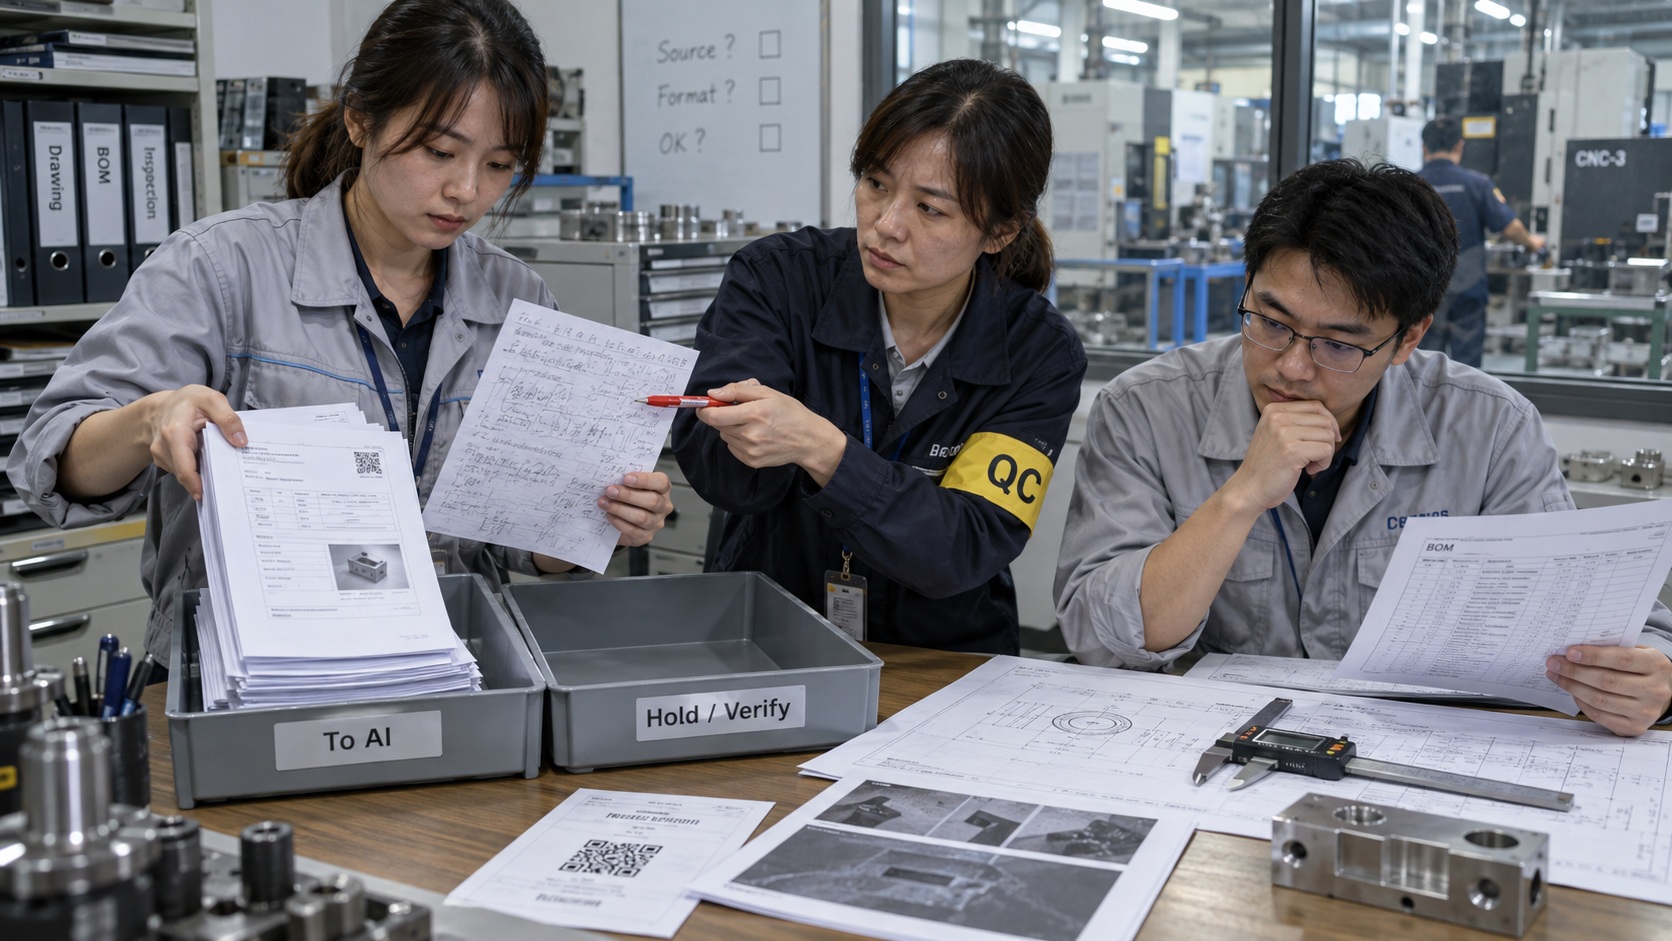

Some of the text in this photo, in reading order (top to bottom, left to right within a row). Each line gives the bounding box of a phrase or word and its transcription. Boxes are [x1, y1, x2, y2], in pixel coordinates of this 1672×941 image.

[656, 32, 736, 64] Source ?
[657, 78, 736, 108] Format ?
[659, 127, 706, 155] OK ?
[97, 146, 111, 184] BOM
[1575, 149, 1626, 167] CNC-3
[48, 145, 64, 211] Drawing
[142, 146, 158, 219] Inspection
[988, 454, 1042, 504] QC
[1425, 543, 1455, 552] BOM
[647, 698, 791, 728] Hold / Verify
[323, 727, 391, 751] To AI
